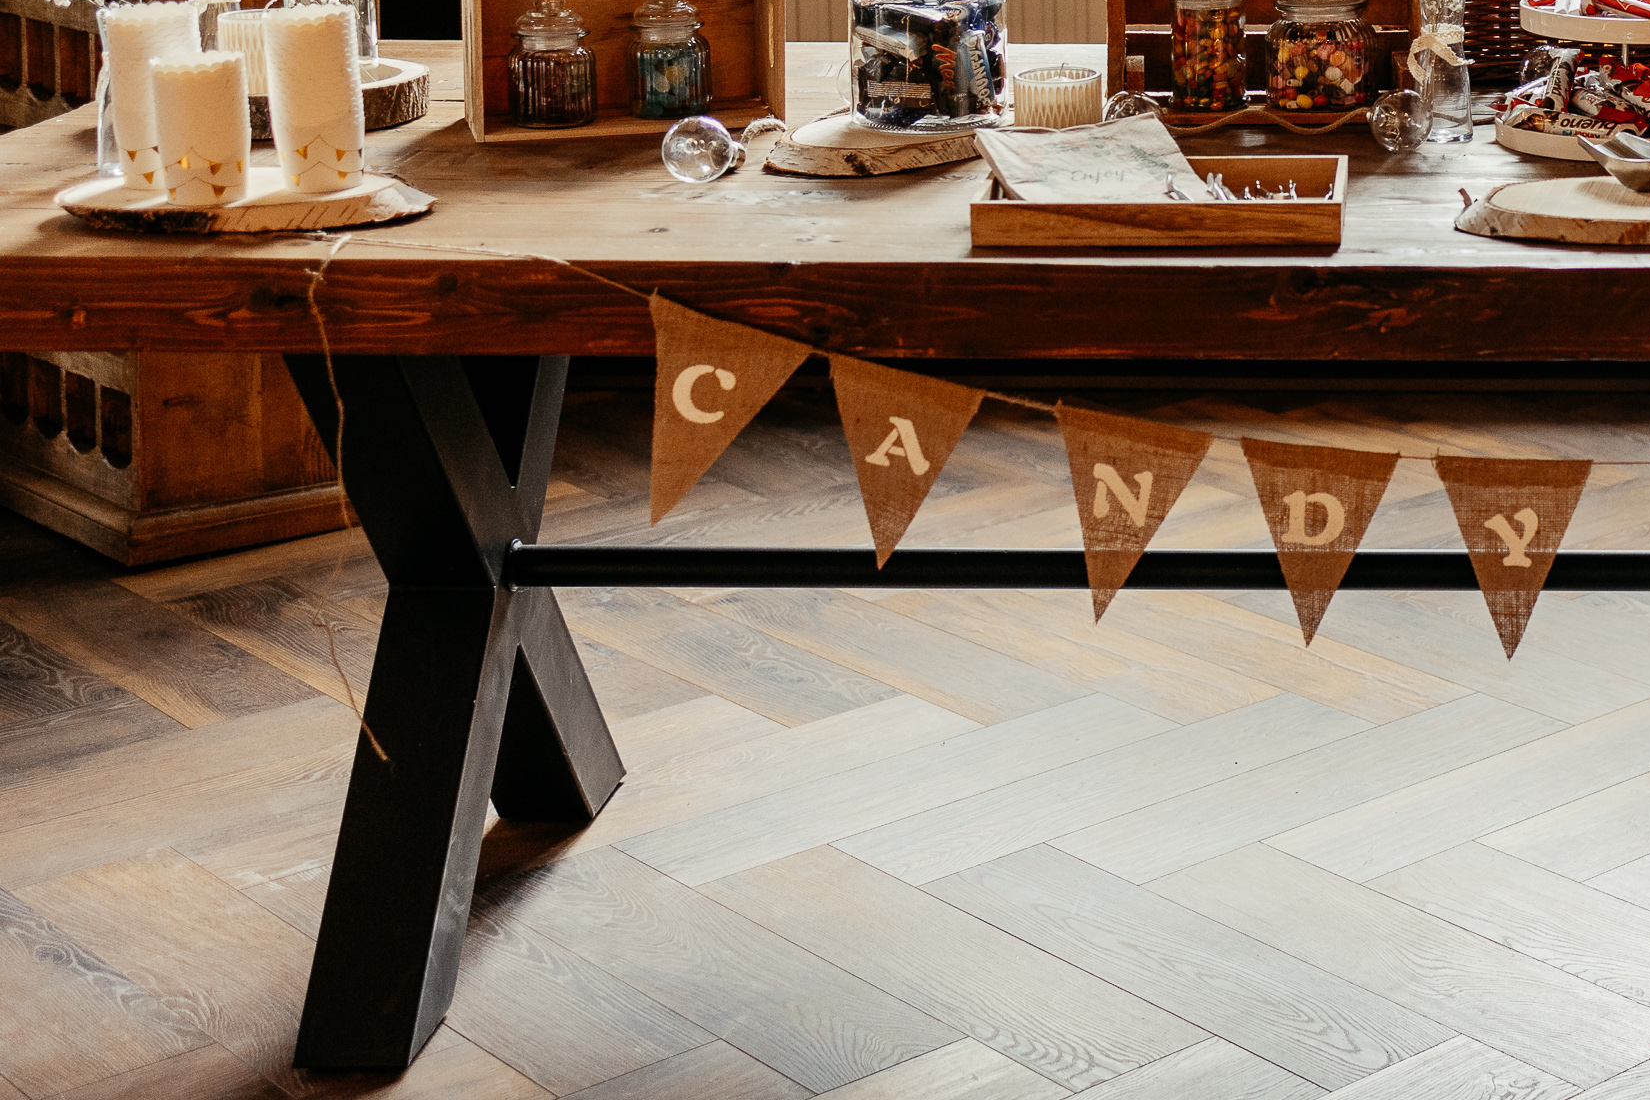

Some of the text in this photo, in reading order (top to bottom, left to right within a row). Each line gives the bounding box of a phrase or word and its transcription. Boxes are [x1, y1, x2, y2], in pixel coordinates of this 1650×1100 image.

[931, 43, 957, 90] Mar
[1560, 117, 1618, 137] bueno
[1070, 168, 1126, 185] Enjoy
